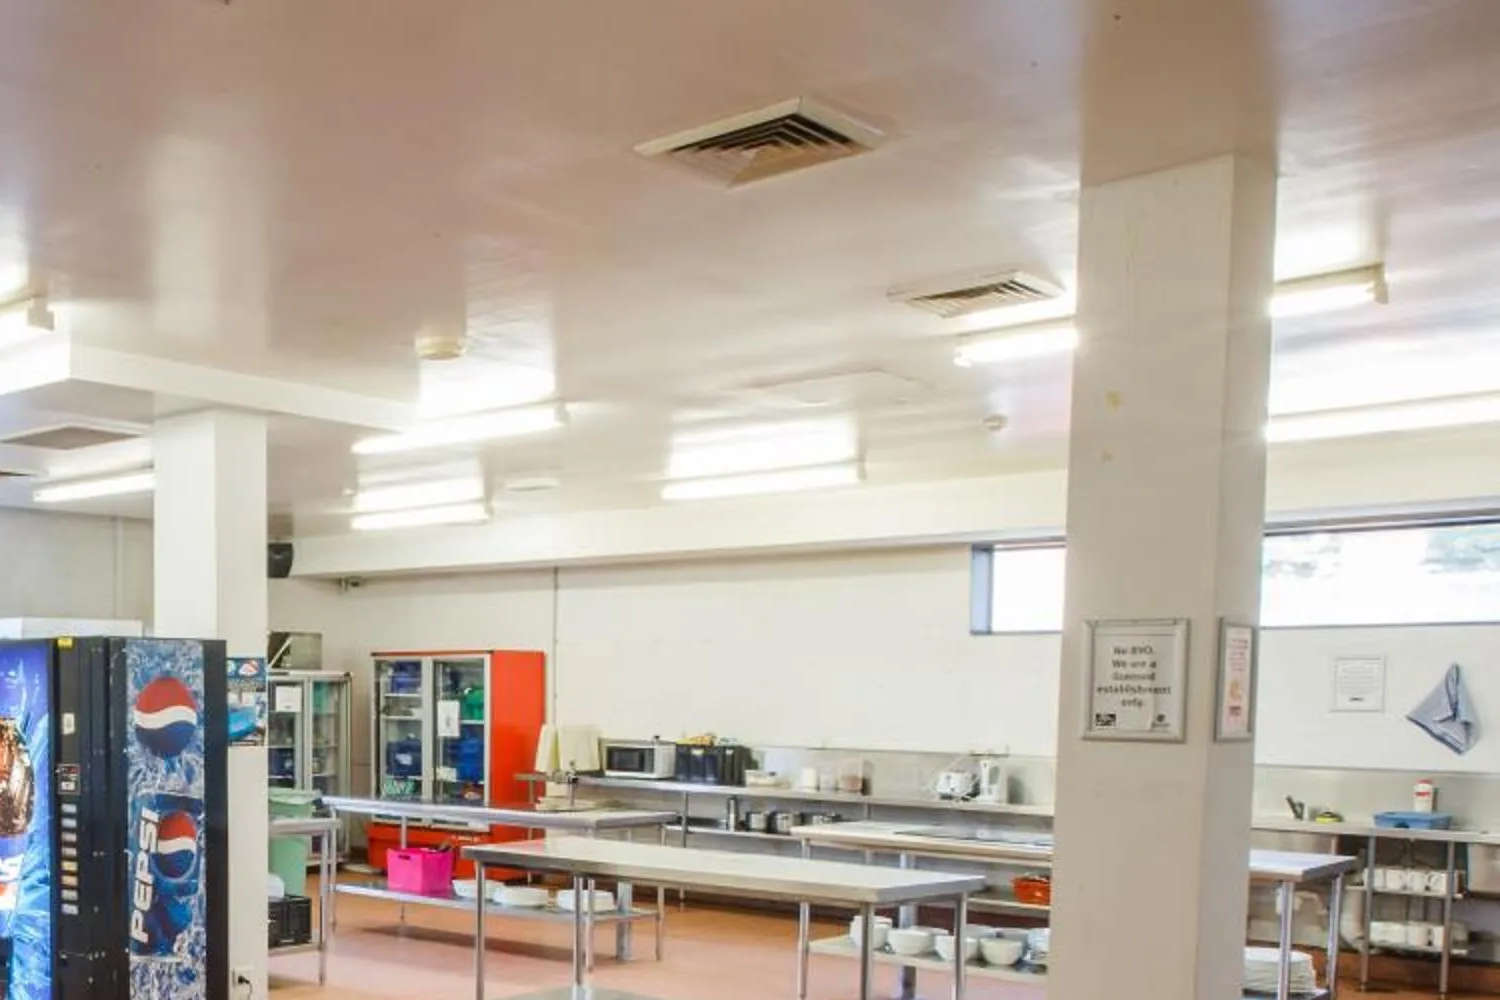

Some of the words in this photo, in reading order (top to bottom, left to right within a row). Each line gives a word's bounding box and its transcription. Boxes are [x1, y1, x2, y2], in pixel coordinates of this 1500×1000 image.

[1111, 660, 1127, 668] We
[1096, 684, 1171, 694] establishment
[131, 806, 160, 944] PEPSI
